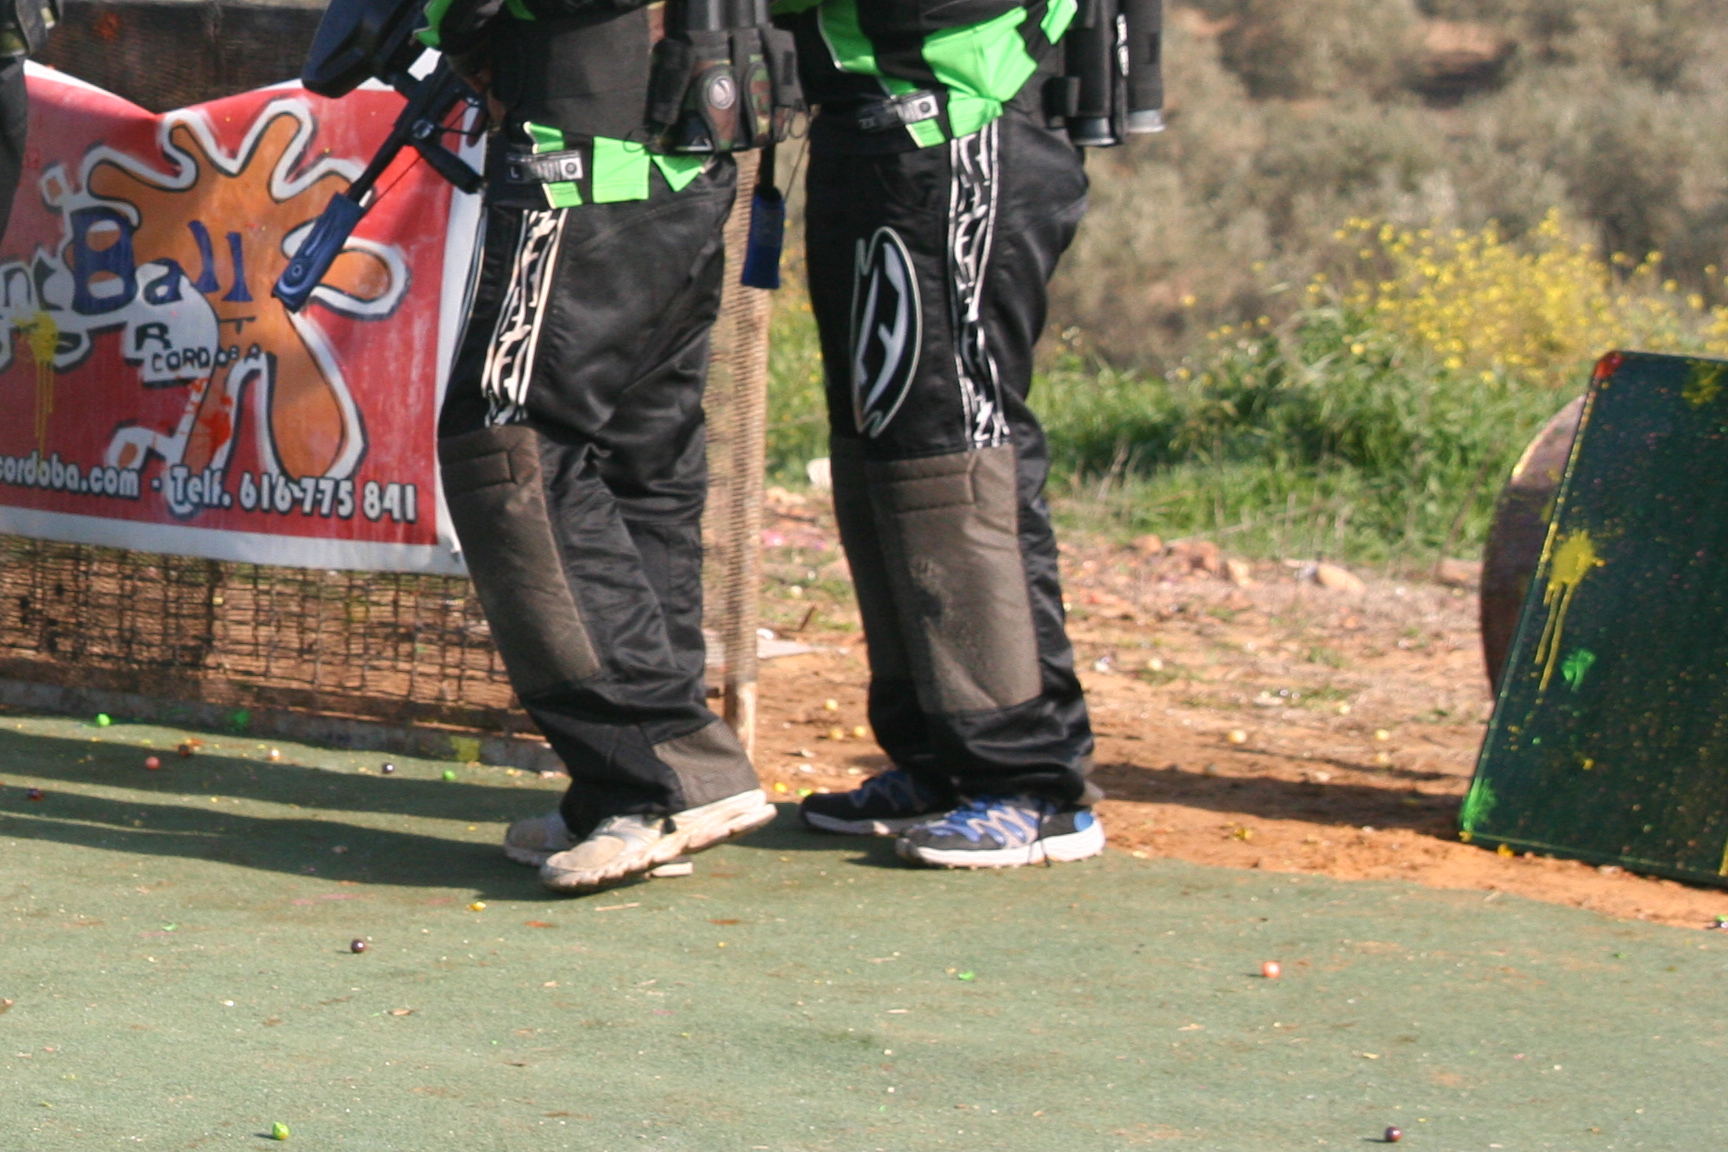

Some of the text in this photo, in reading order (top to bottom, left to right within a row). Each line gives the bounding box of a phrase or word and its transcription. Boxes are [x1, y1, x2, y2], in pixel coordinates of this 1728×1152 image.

[152, 343, 261, 373] CORDOBA
[171, 465, 232, 507] Telf.
[362, 481, 417, 523] 841
